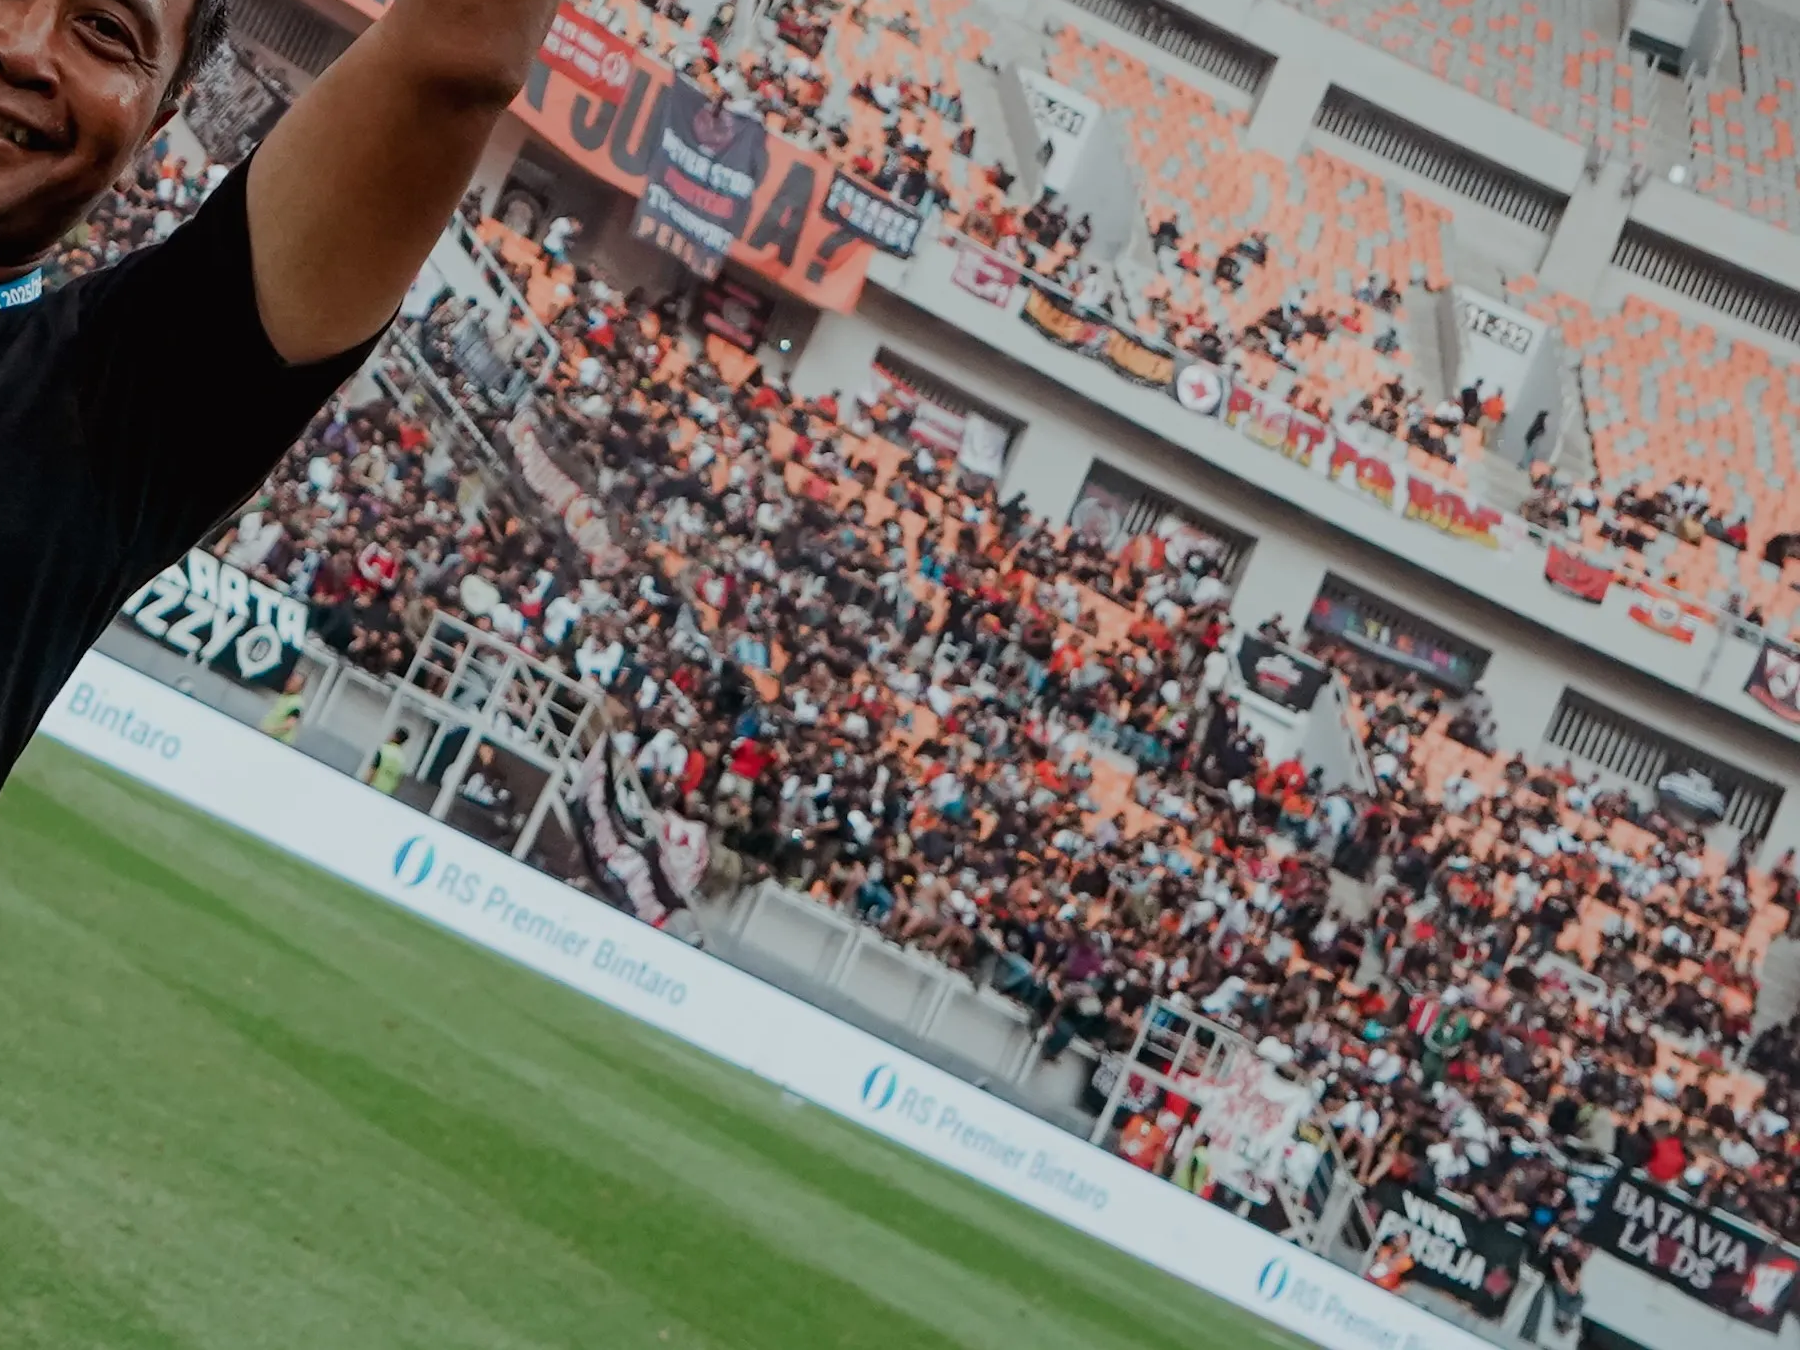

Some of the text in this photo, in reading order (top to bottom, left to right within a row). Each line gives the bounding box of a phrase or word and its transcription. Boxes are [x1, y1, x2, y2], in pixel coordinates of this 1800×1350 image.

[67, 681, 183, 761] Bintaro
[436, 861, 689, 1007] RS Premier Bintaro
[897, 1085, 938, 1127] RS
[935, 1104, 1028, 1172] Premier
[1612, 1181, 1750, 1275] BATAVIA
